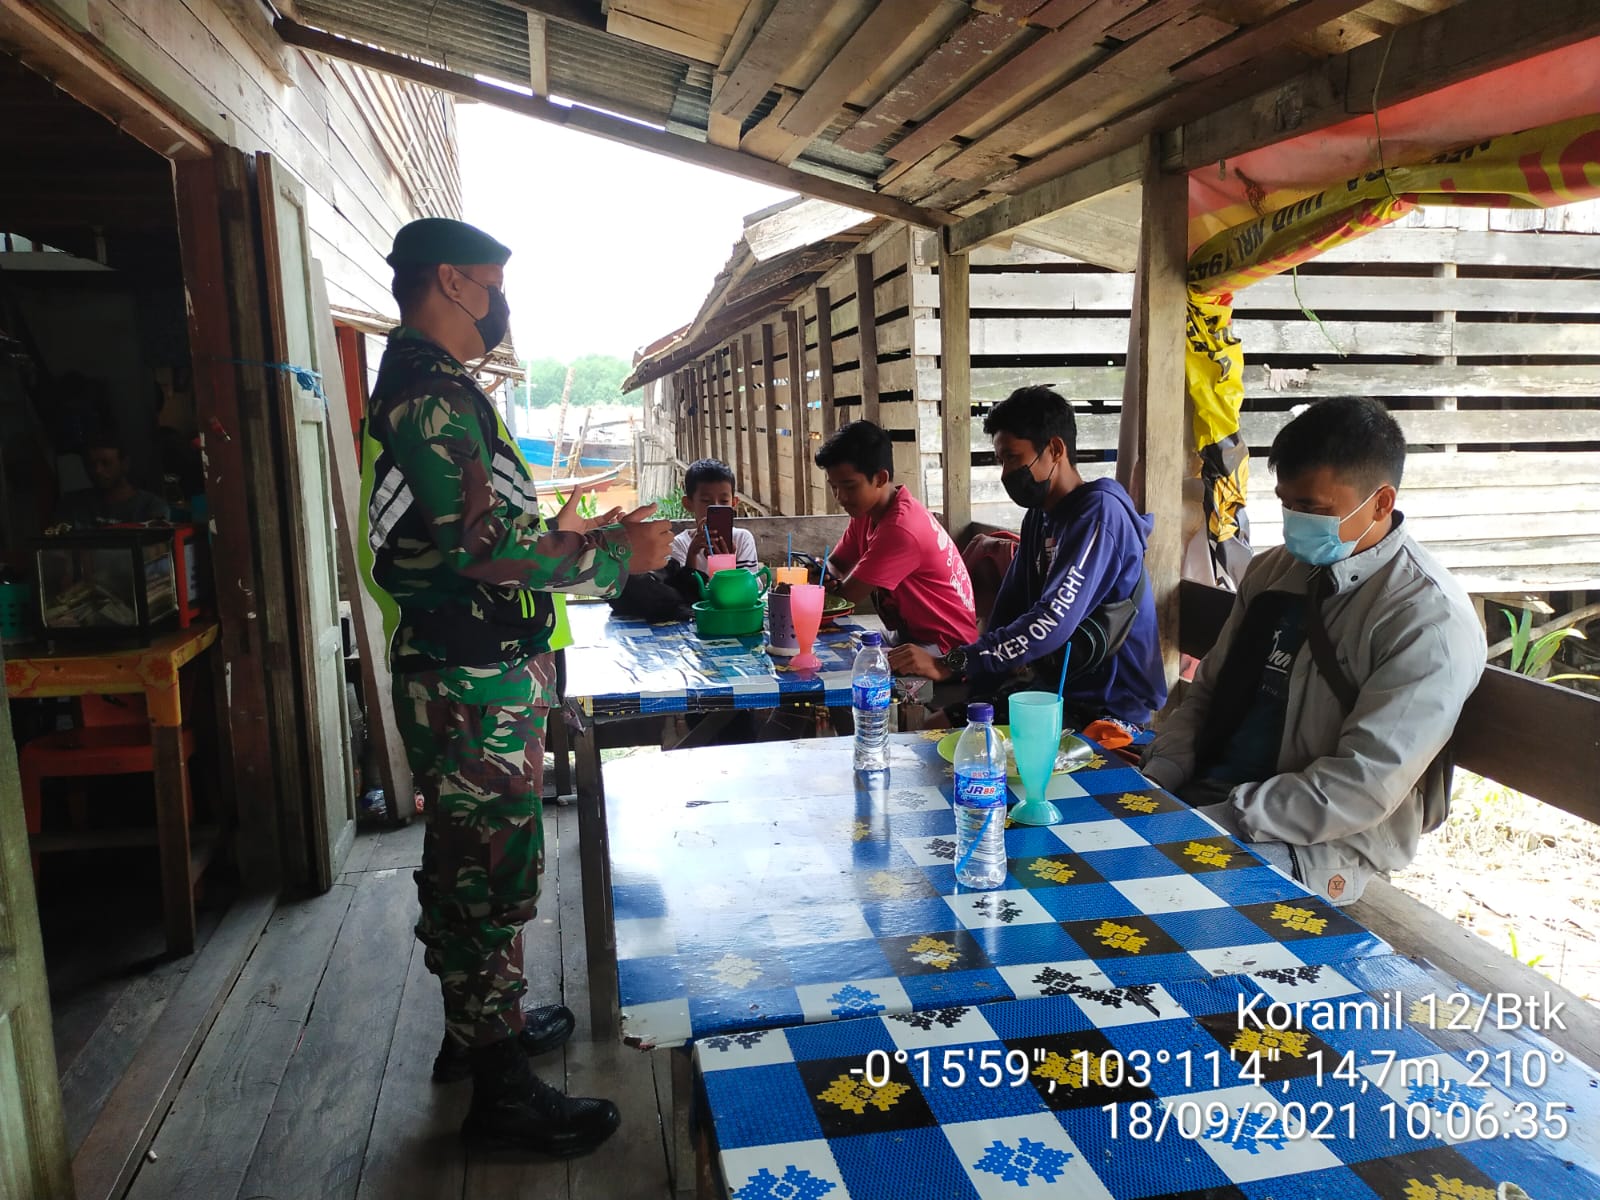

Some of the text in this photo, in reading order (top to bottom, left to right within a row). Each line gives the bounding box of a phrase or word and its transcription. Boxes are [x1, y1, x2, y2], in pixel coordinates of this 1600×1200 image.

[991, 565, 1086, 663] KEEP ON FIGHT
